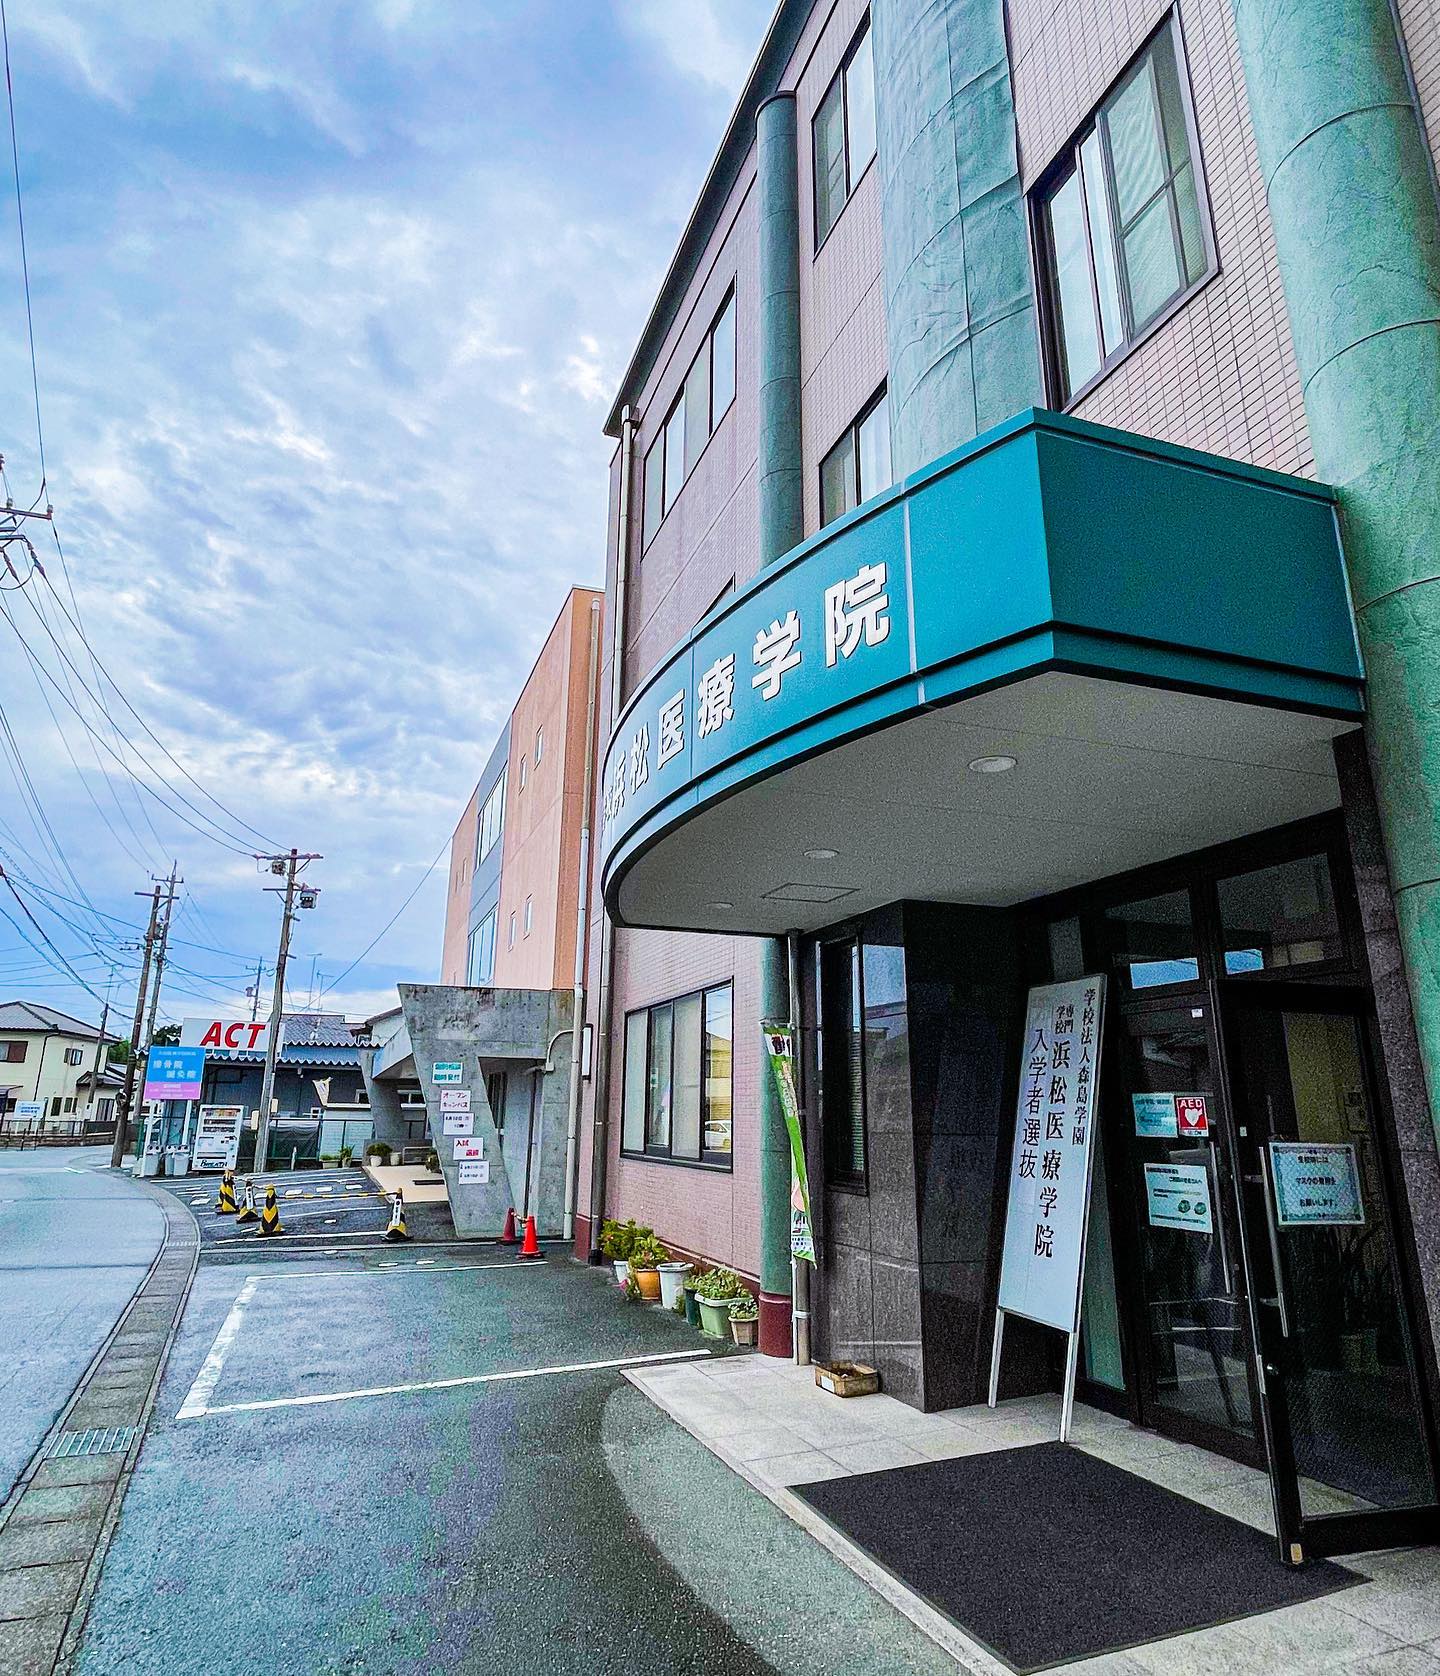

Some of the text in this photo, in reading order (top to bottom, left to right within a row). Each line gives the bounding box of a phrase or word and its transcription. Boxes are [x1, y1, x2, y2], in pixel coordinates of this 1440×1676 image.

[200, 1022, 266, 1049] ACT
[1018, 1028, 1049, 1180] 入学者選抜
[1072, 988, 1098, 1146] 学校法人森島学園
[1179, 1099, 1203, 1108] AED
[1034, 1040, 1071, 1259] 浜松医療学院
